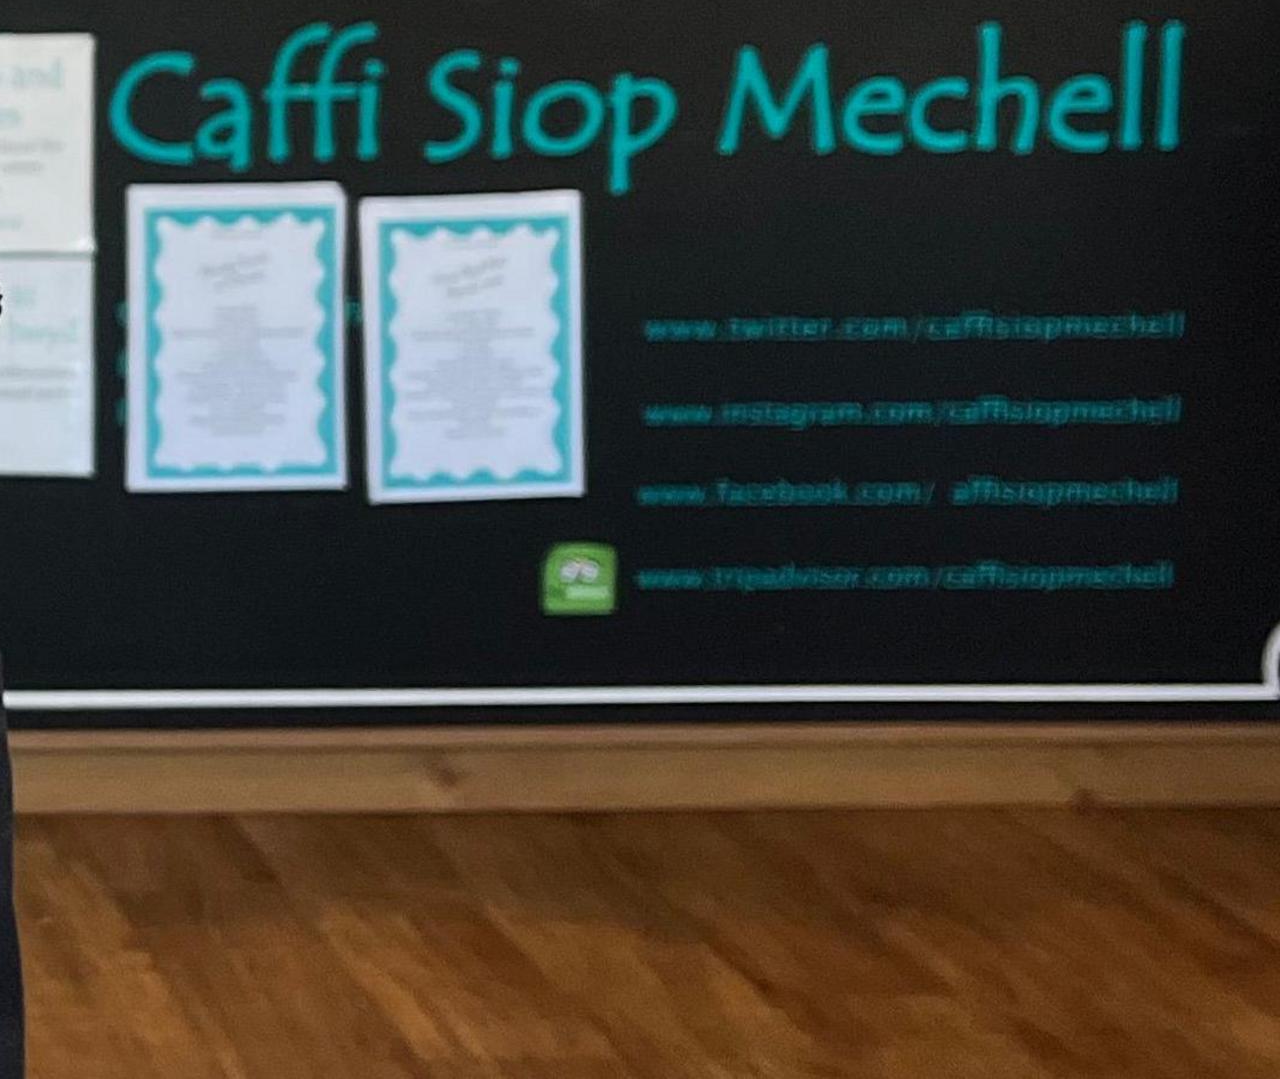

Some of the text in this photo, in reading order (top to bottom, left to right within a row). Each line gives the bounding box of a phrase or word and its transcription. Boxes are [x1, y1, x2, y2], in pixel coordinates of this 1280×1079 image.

[109, 20, 1184, 195] Caffi Siop Mechell
